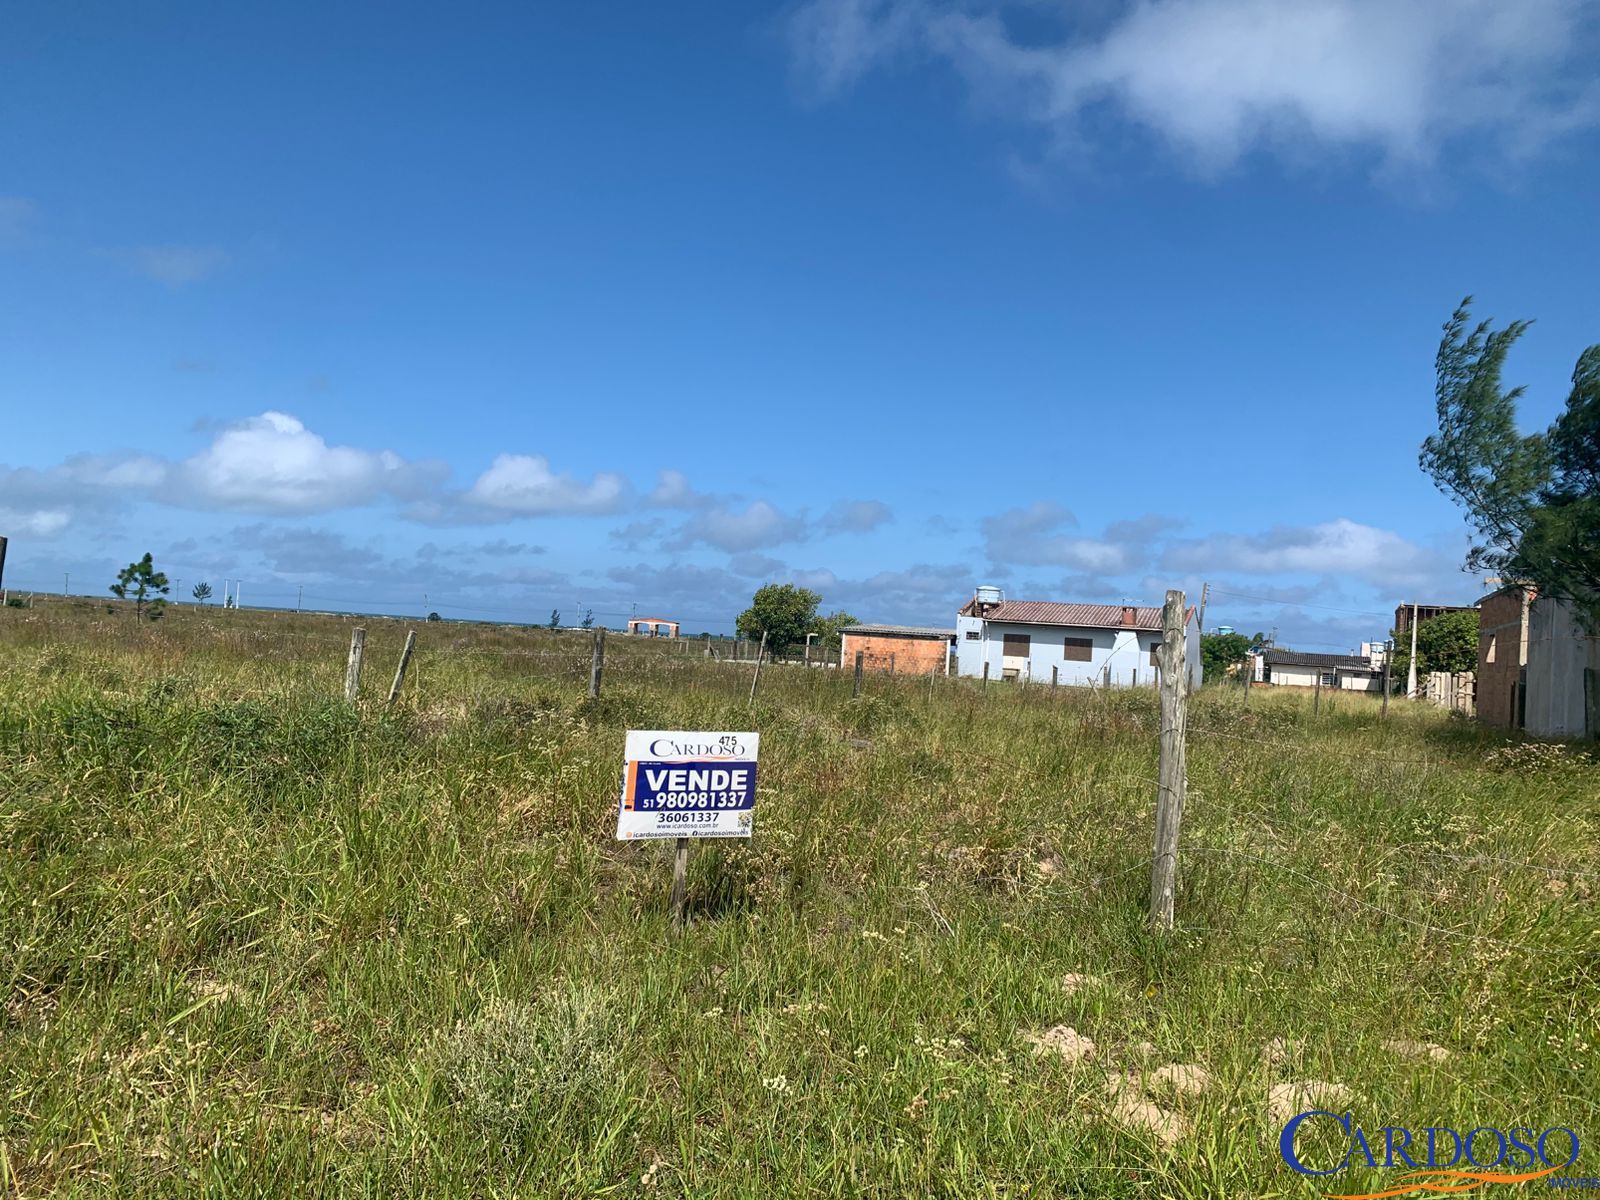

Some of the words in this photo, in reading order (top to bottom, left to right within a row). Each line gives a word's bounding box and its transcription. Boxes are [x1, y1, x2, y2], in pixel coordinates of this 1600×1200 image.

[649, 738, 745, 757] CARDOSO
[719, 736, 737, 746] 475
[645, 769, 748, 791] VENDE
[643, 799, 654, 808] 51
[656, 791, 747, 809] 980981337
[658, 812, 720, 823] 36061337
